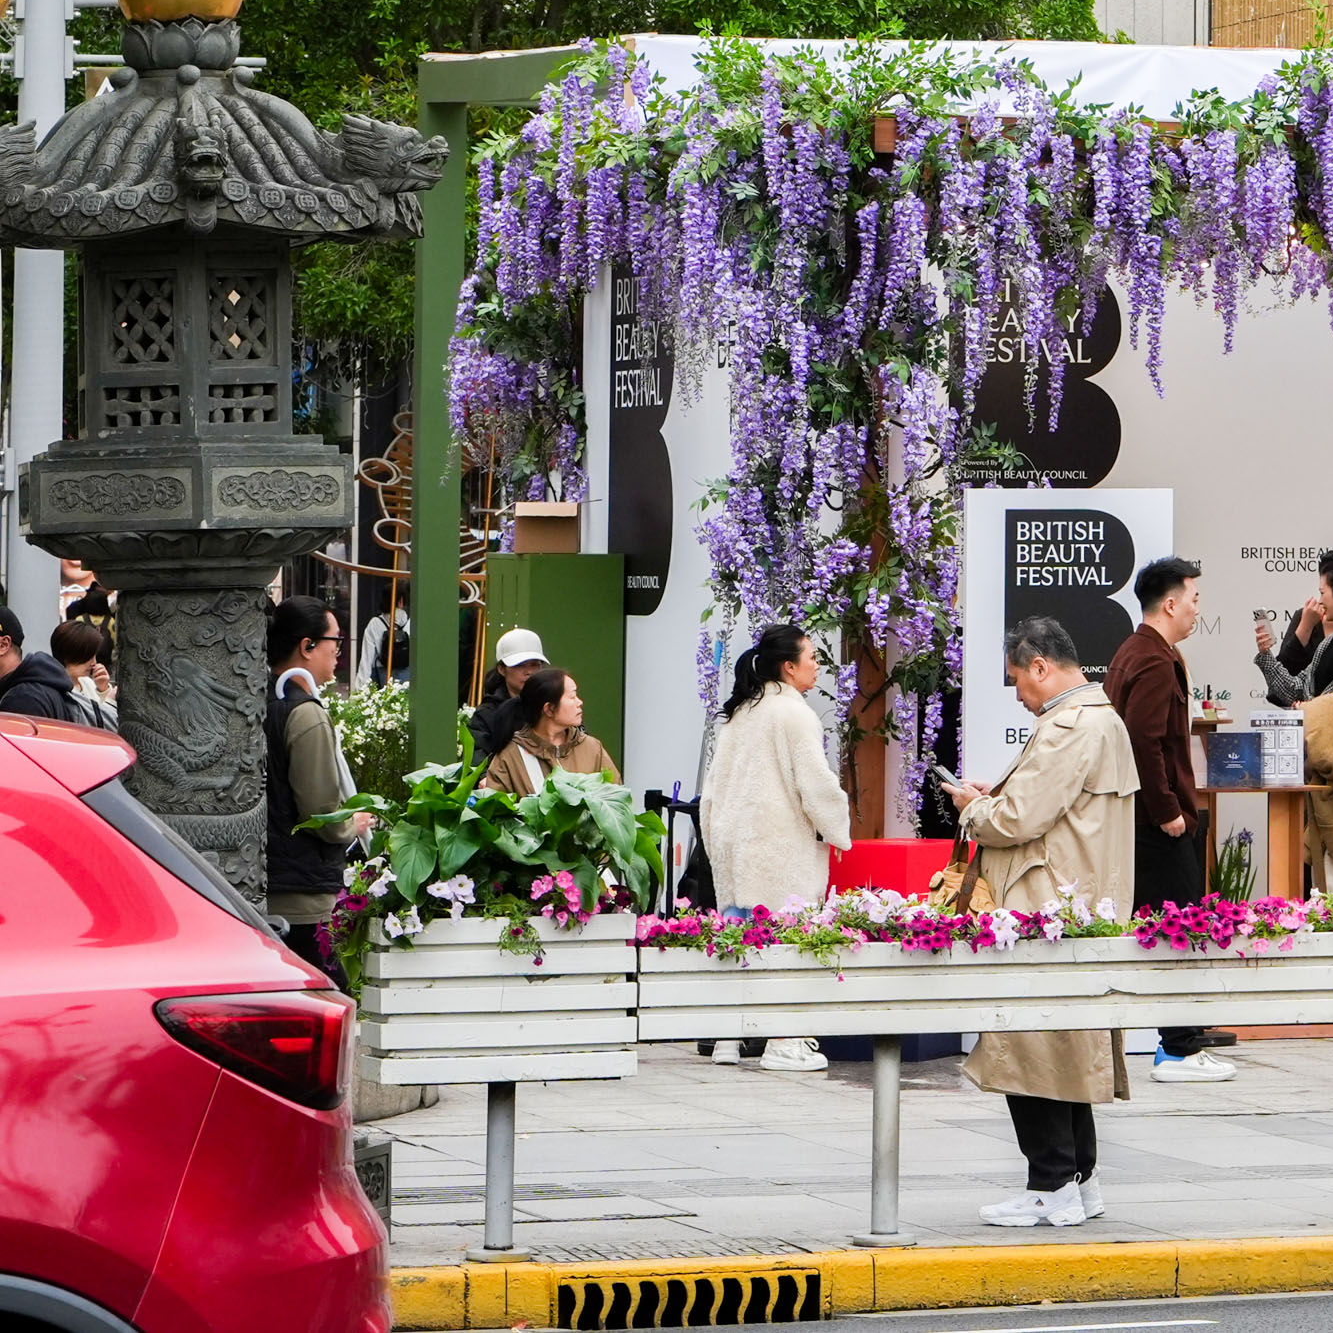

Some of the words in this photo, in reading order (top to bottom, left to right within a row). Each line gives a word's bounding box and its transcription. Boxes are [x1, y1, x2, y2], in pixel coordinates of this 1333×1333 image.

[1004, 470, 1043, 480] BEAUTY
[1043, 470, 1088, 480] COUNCIL
[1016, 521, 1105, 541] BRITISH
[1016, 543, 1105, 563] BEAUTY
[1241, 547, 1295, 559] BRITISH
[1016, 566, 1113, 586] FESTIVAL
[1080, 666, 1108, 674] OUNCIL
